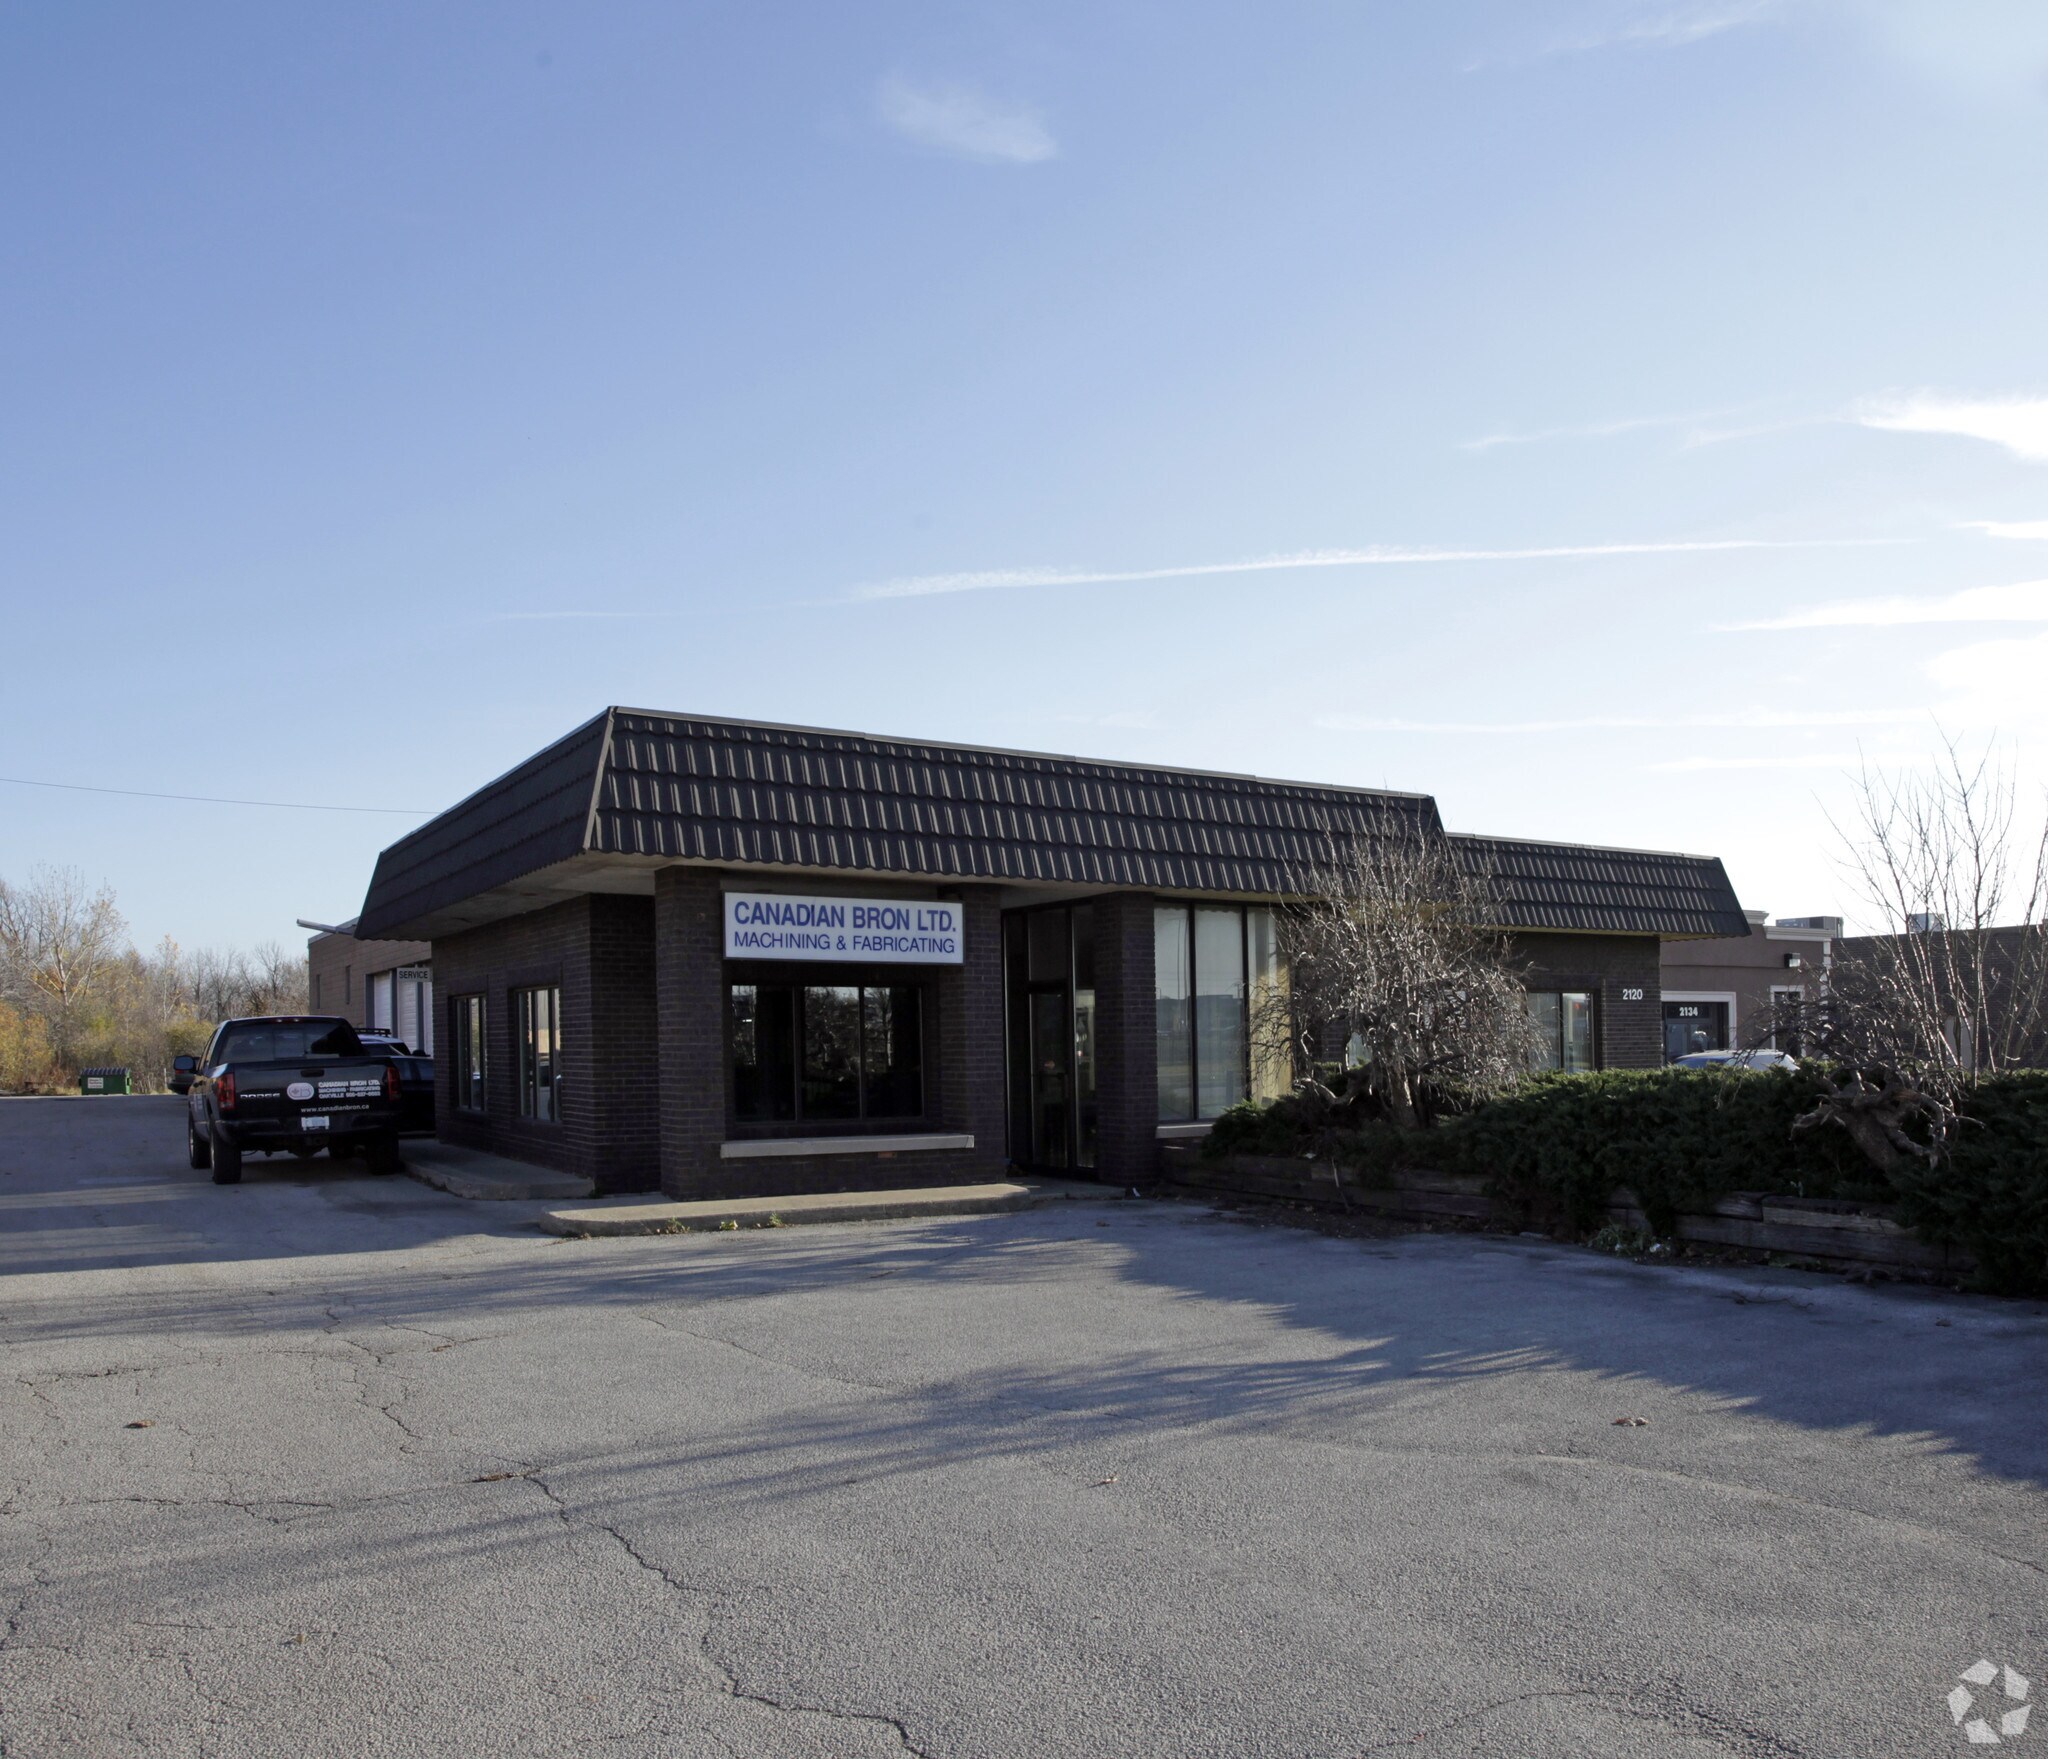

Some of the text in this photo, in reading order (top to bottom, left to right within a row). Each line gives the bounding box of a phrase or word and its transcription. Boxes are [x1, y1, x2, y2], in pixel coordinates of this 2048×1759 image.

[734, 901, 957, 932] CANADIAN BRON LTD.
[734, 931, 955, 953] MACHINING & FABRICATING
[399, 970, 428, 979] SERVICE
[1622, 988, 1643, 1000] 2120
[1679, 1006, 1699, 1017] 2134
[301, 1104, 370, 1113] www.canadianbron.ca
